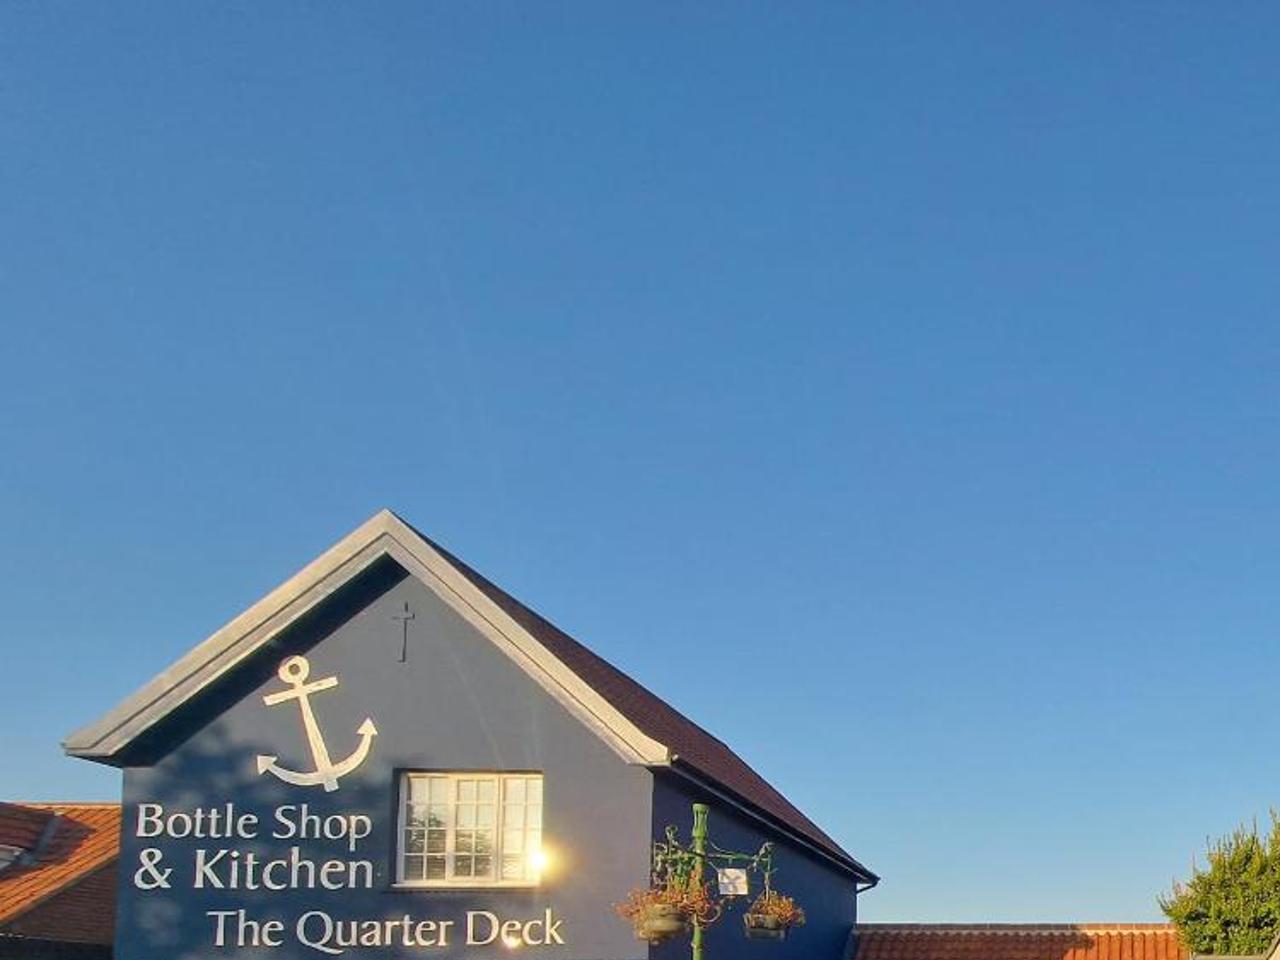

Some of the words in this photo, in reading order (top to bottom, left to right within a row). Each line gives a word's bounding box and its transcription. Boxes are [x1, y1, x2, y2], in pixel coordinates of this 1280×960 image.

[136, 803, 259, 839] Bottle
[272, 804, 373, 852] Shop
[133, 847, 172, 890] &
[193, 846, 374, 891] Kitchen
[206, 909, 285, 947] The
[296, 910, 454, 955] Quarter
[466, 908, 566, 946] Deck
